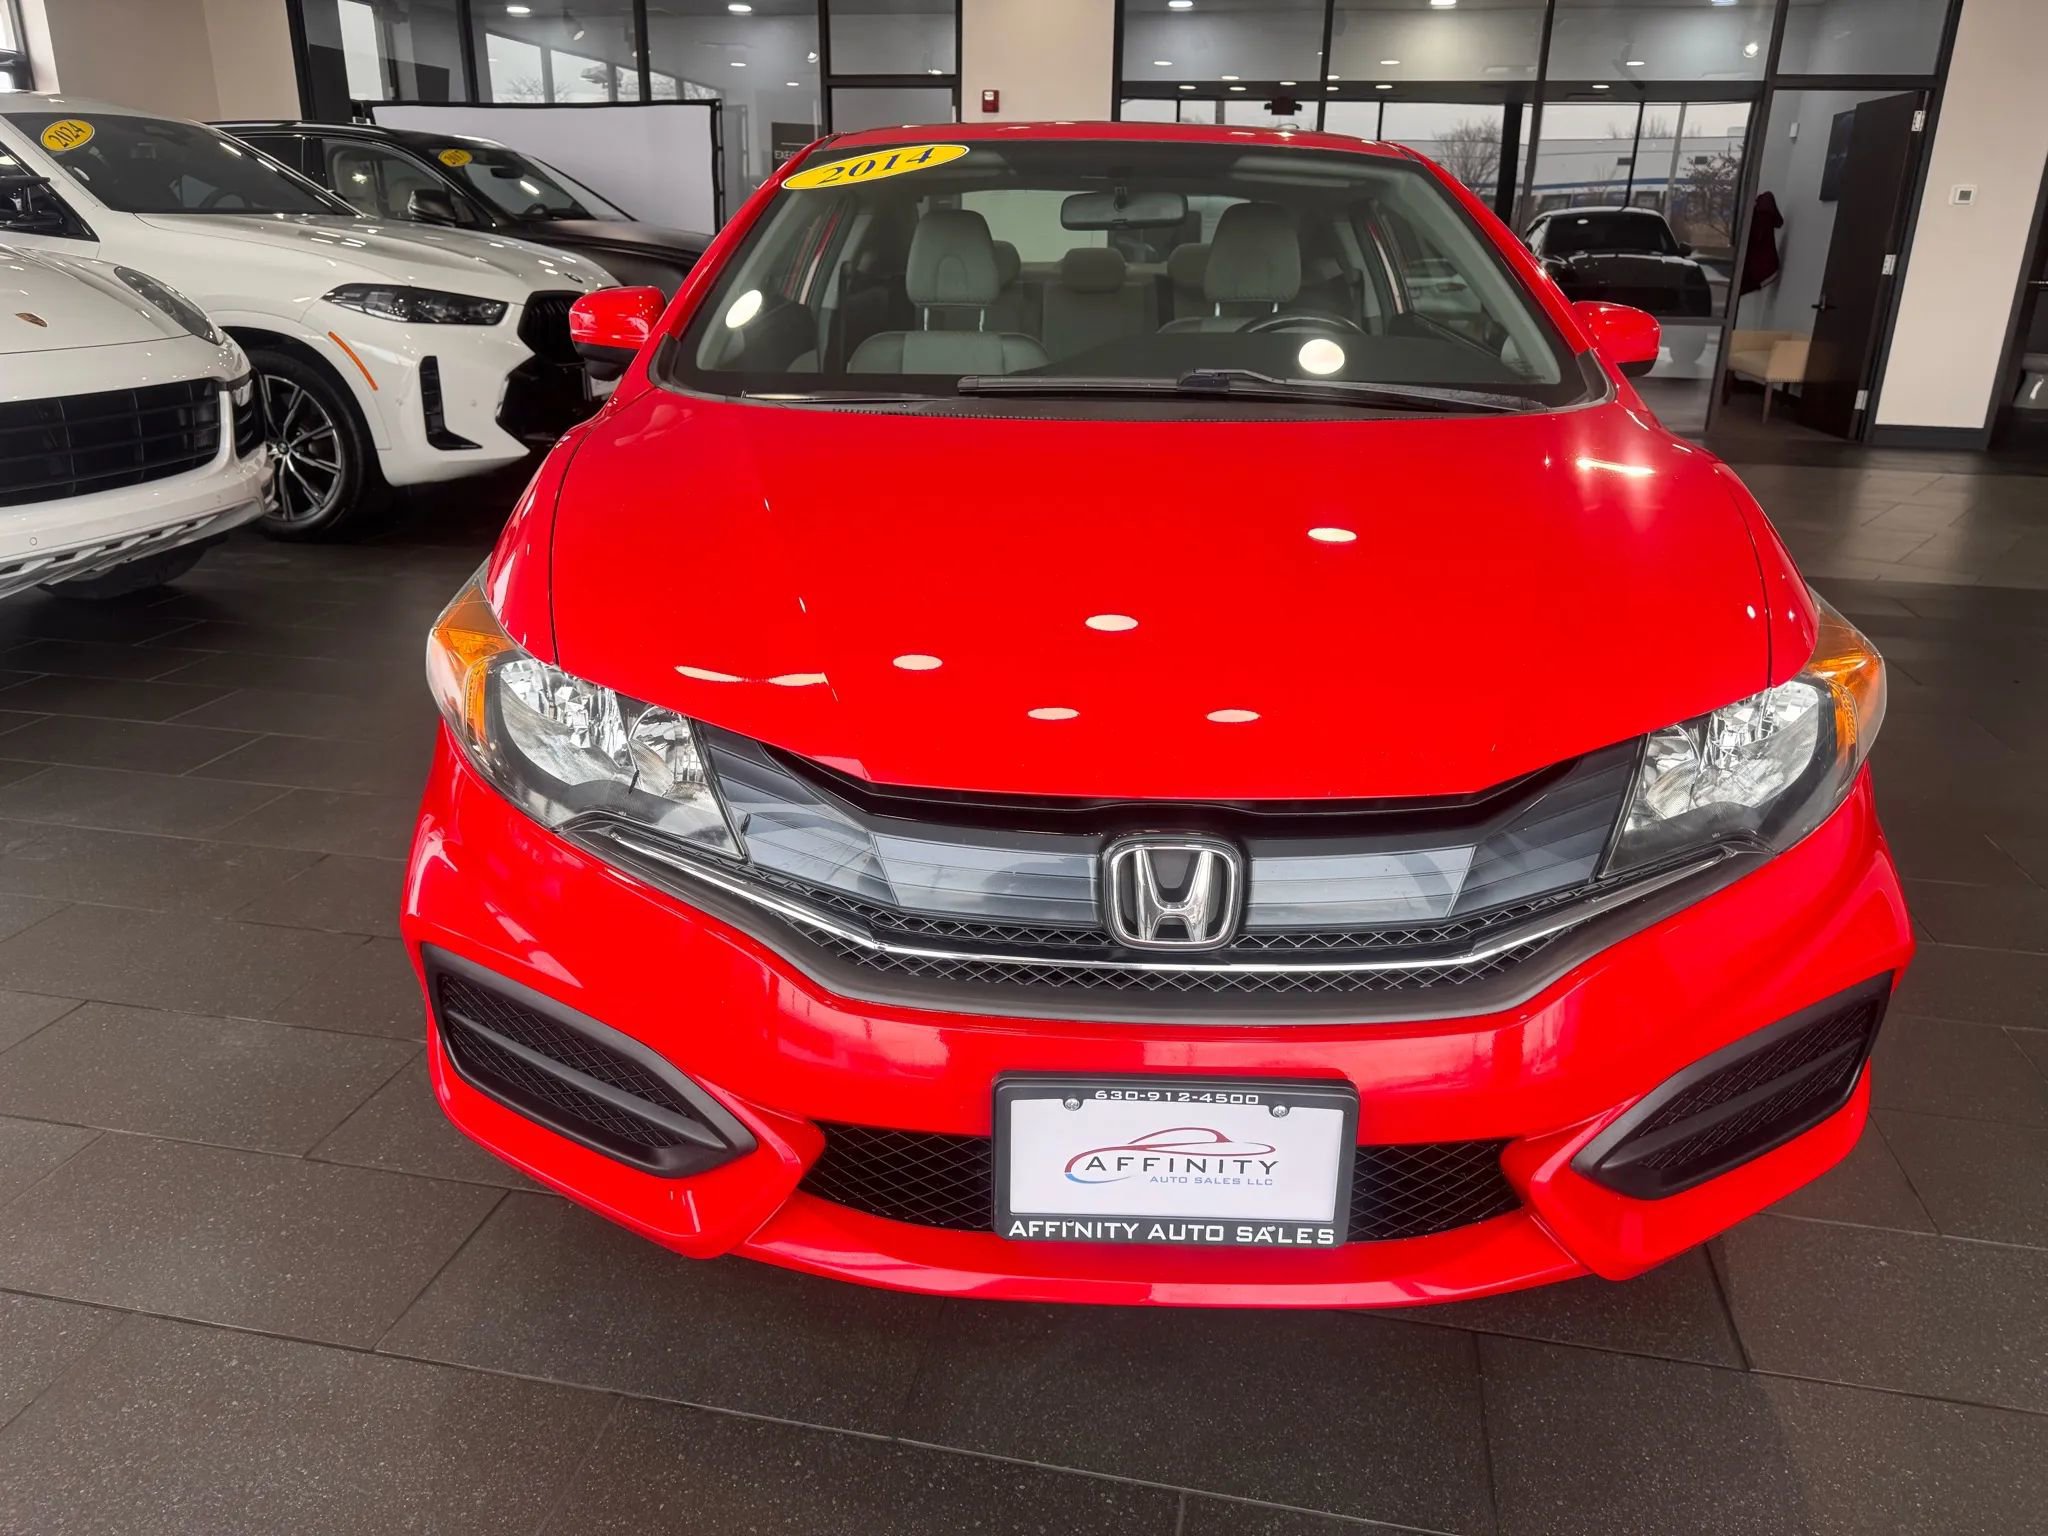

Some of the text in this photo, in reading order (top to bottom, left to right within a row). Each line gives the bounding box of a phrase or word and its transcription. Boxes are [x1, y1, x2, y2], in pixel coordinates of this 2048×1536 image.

[48, 121, 86, 148] 2024
[816, 147, 935, 185] 2014
[1094, 1090, 1260, 1105] 630-912-4500
[1084, 1156, 1279, 1176] AFFINITY
[1149, 1175, 1274, 1187] AUTO SALES LLC
[1008, 1220, 1335, 1245] AFFINITY AUTO SALES
